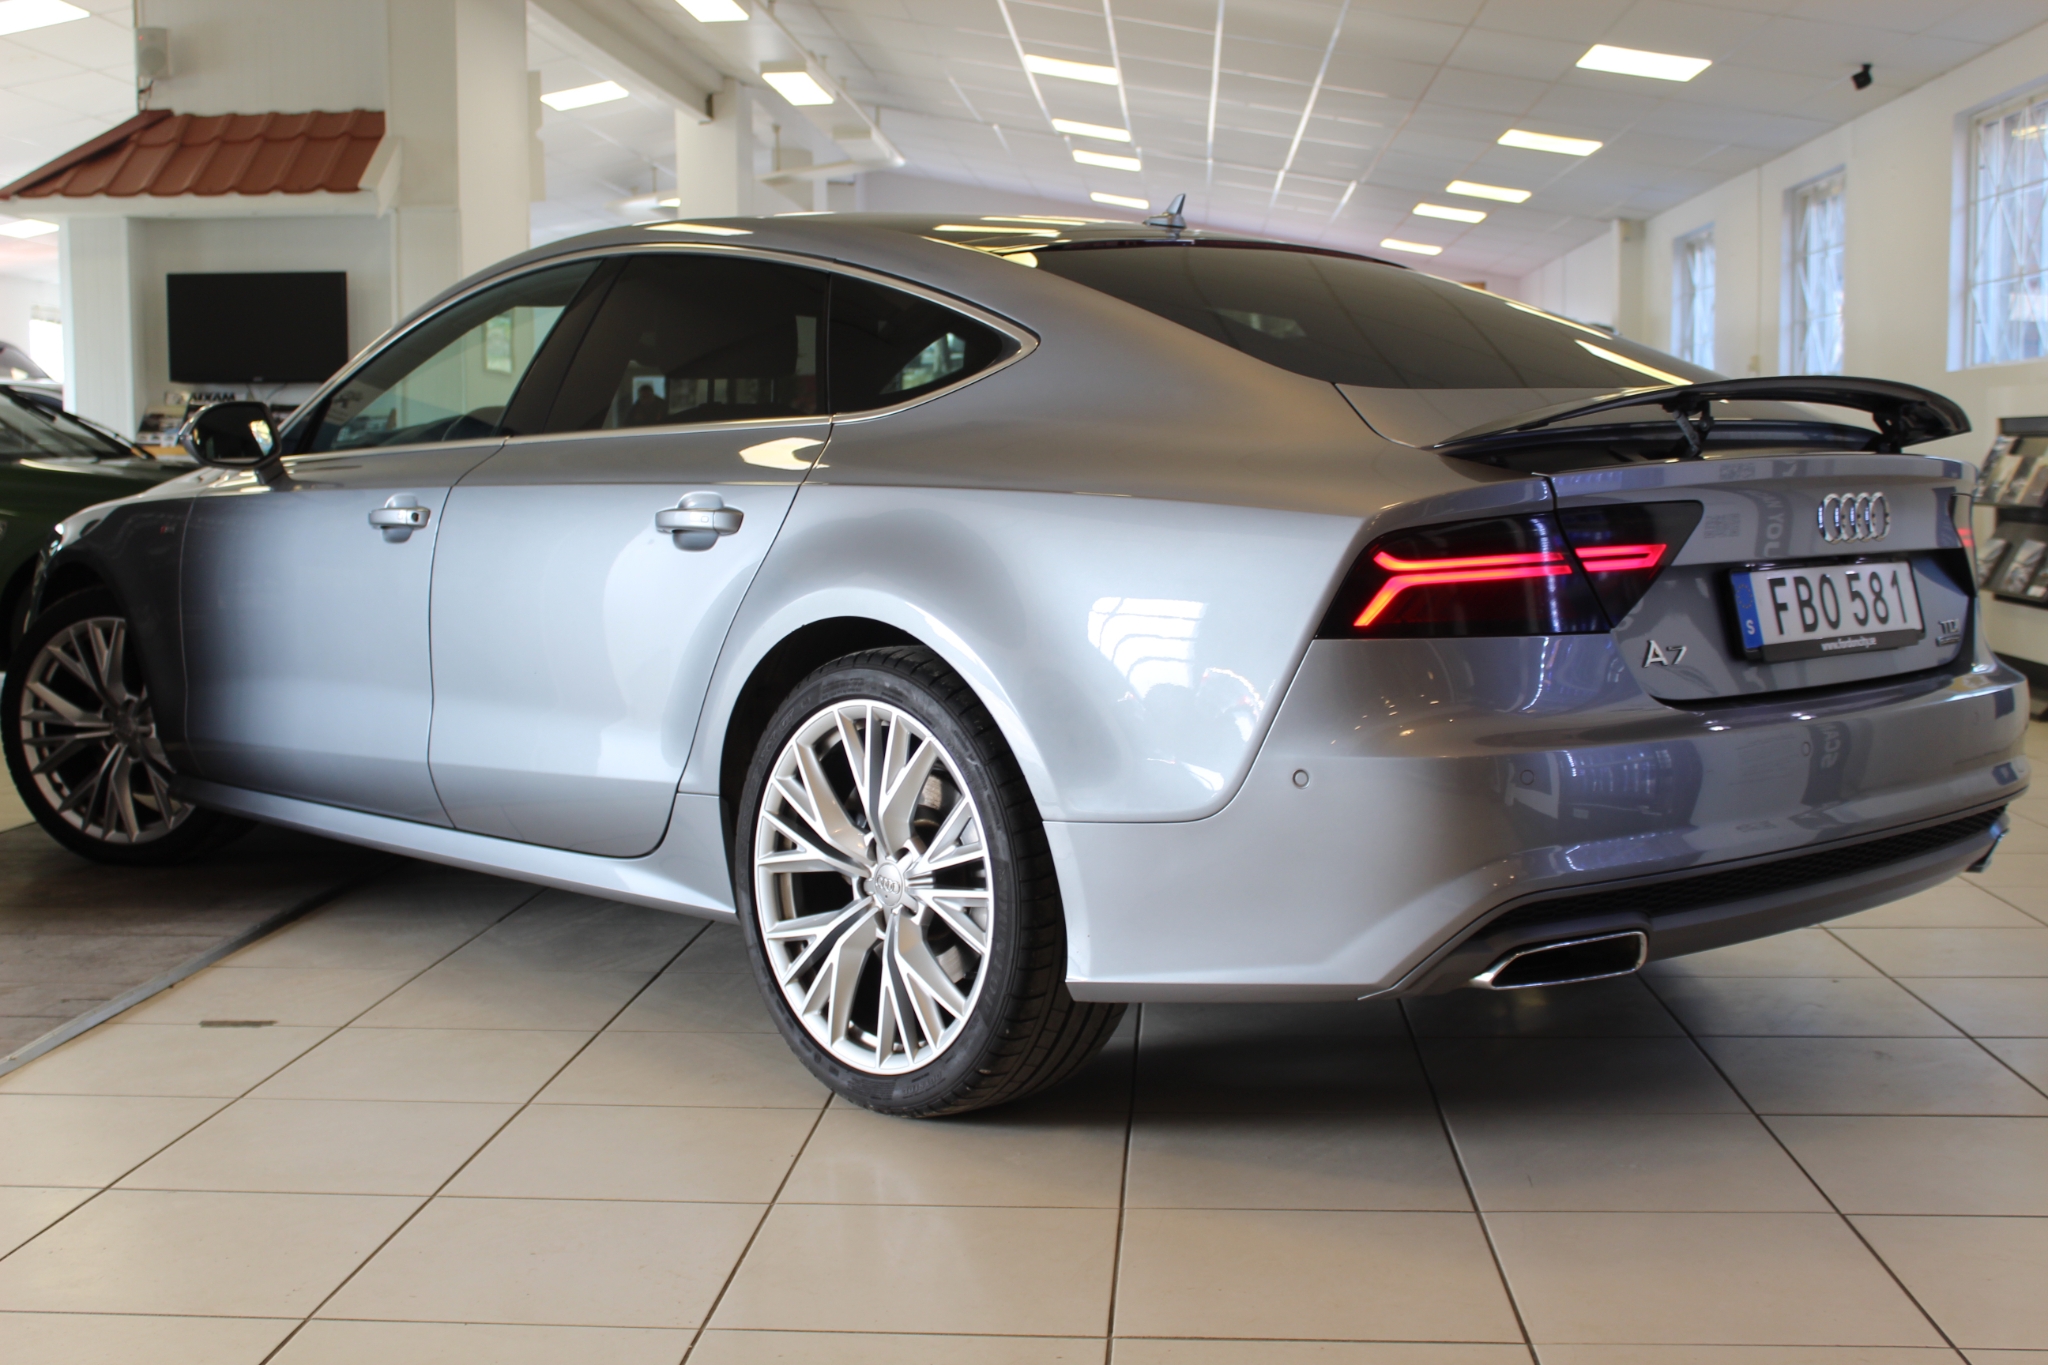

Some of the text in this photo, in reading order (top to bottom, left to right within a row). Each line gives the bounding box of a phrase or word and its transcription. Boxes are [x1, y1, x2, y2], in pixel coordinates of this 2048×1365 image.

[190, 391, 236, 402] AIXAM
[1847, 570, 1907, 626] 581
[1746, 619, 1756, 635] S
[1644, 639, 1688, 668] A7
